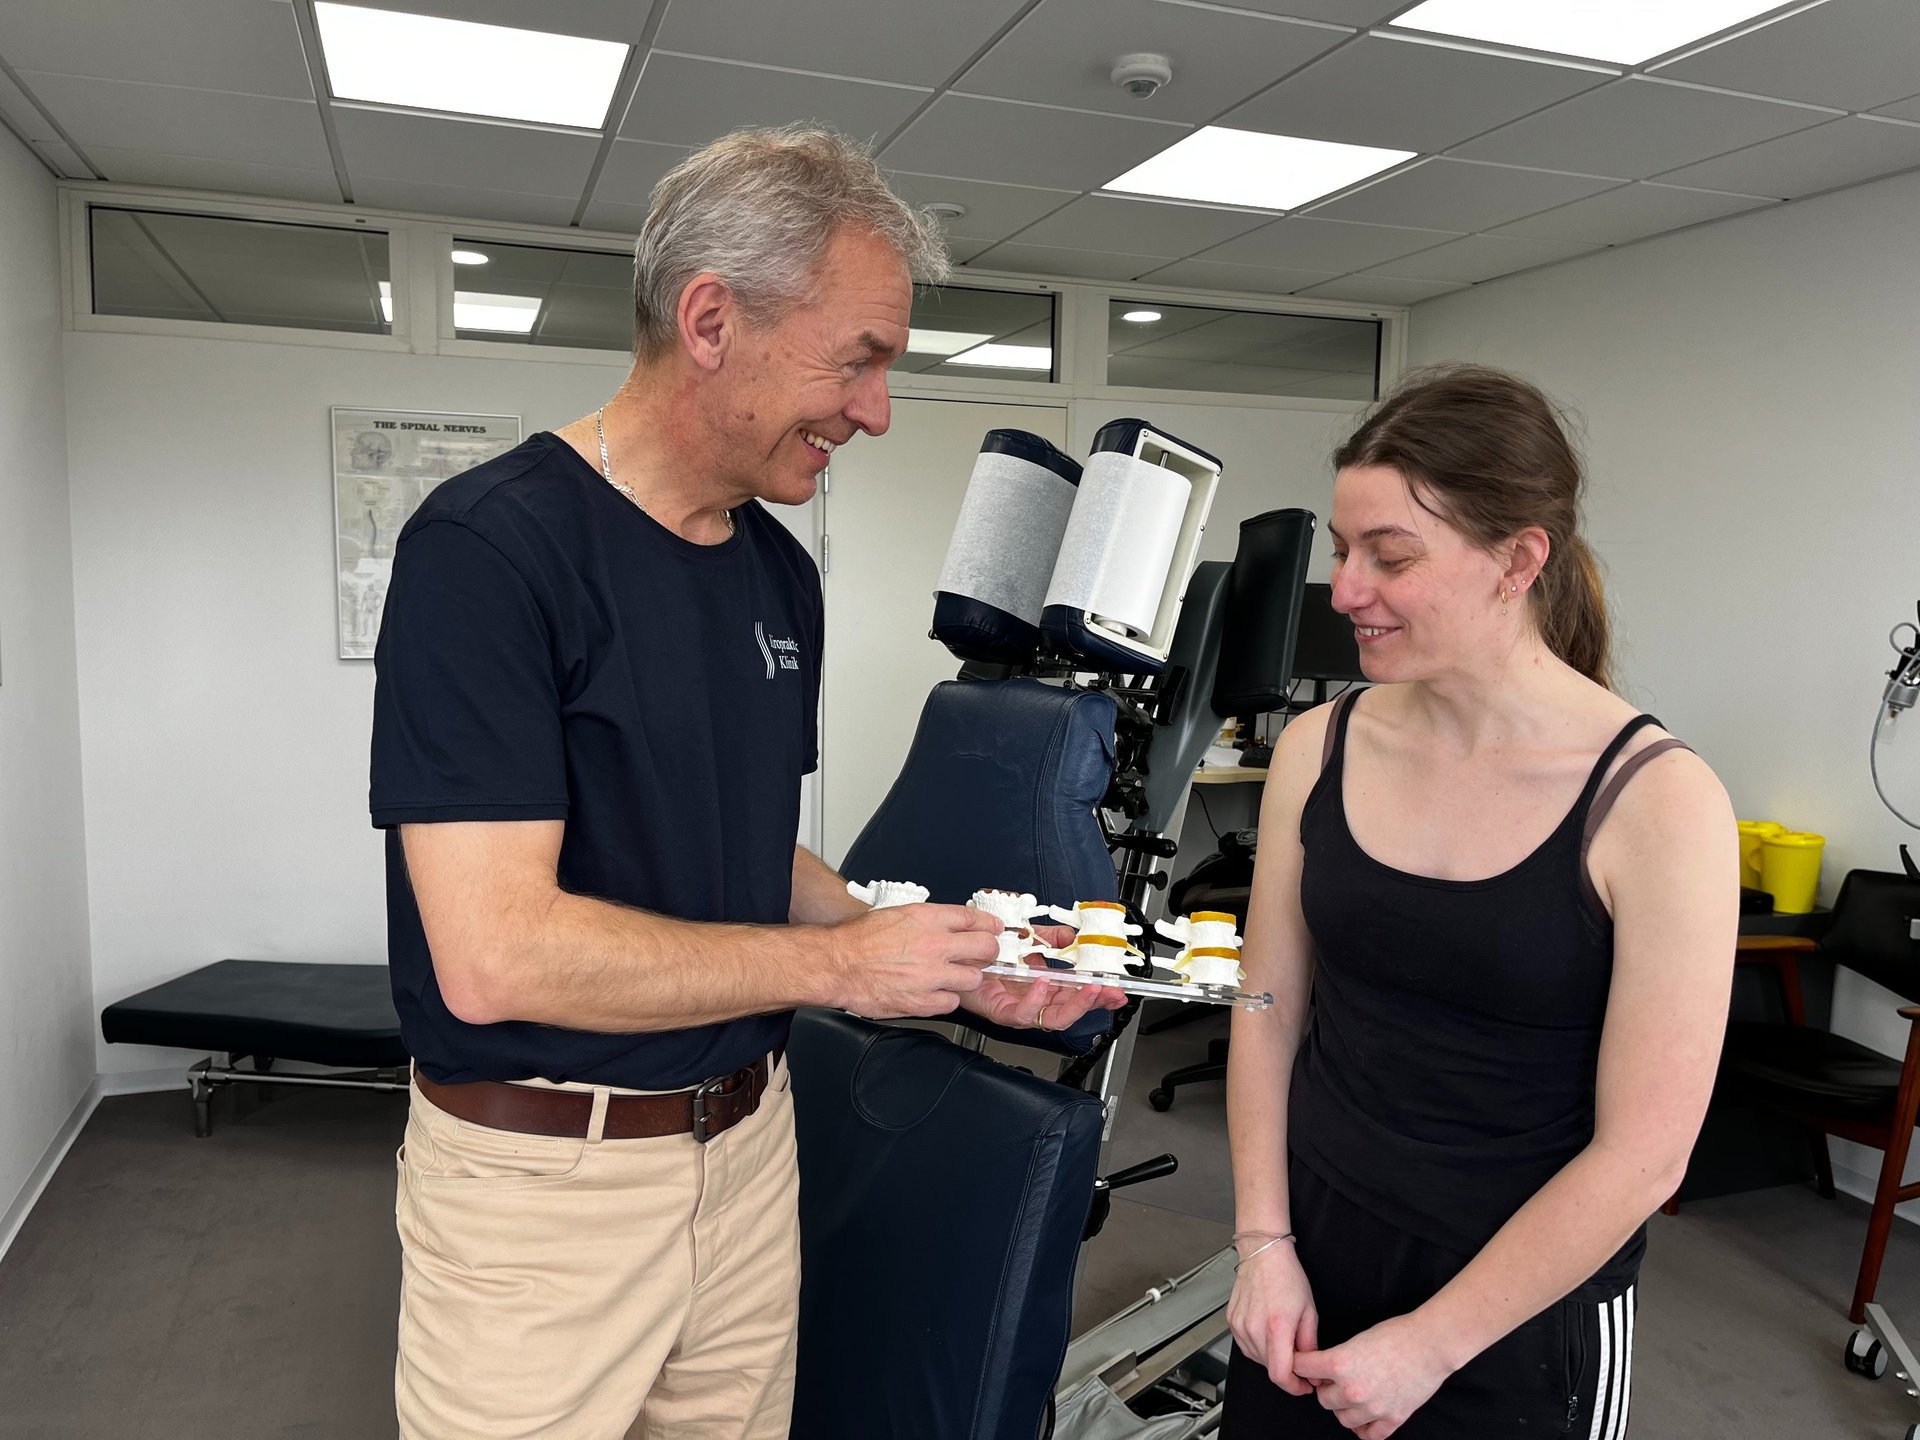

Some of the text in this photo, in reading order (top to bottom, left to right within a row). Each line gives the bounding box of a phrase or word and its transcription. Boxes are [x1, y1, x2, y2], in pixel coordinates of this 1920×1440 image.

[373, 421, 486, 433] THE SPINAL NERVES
